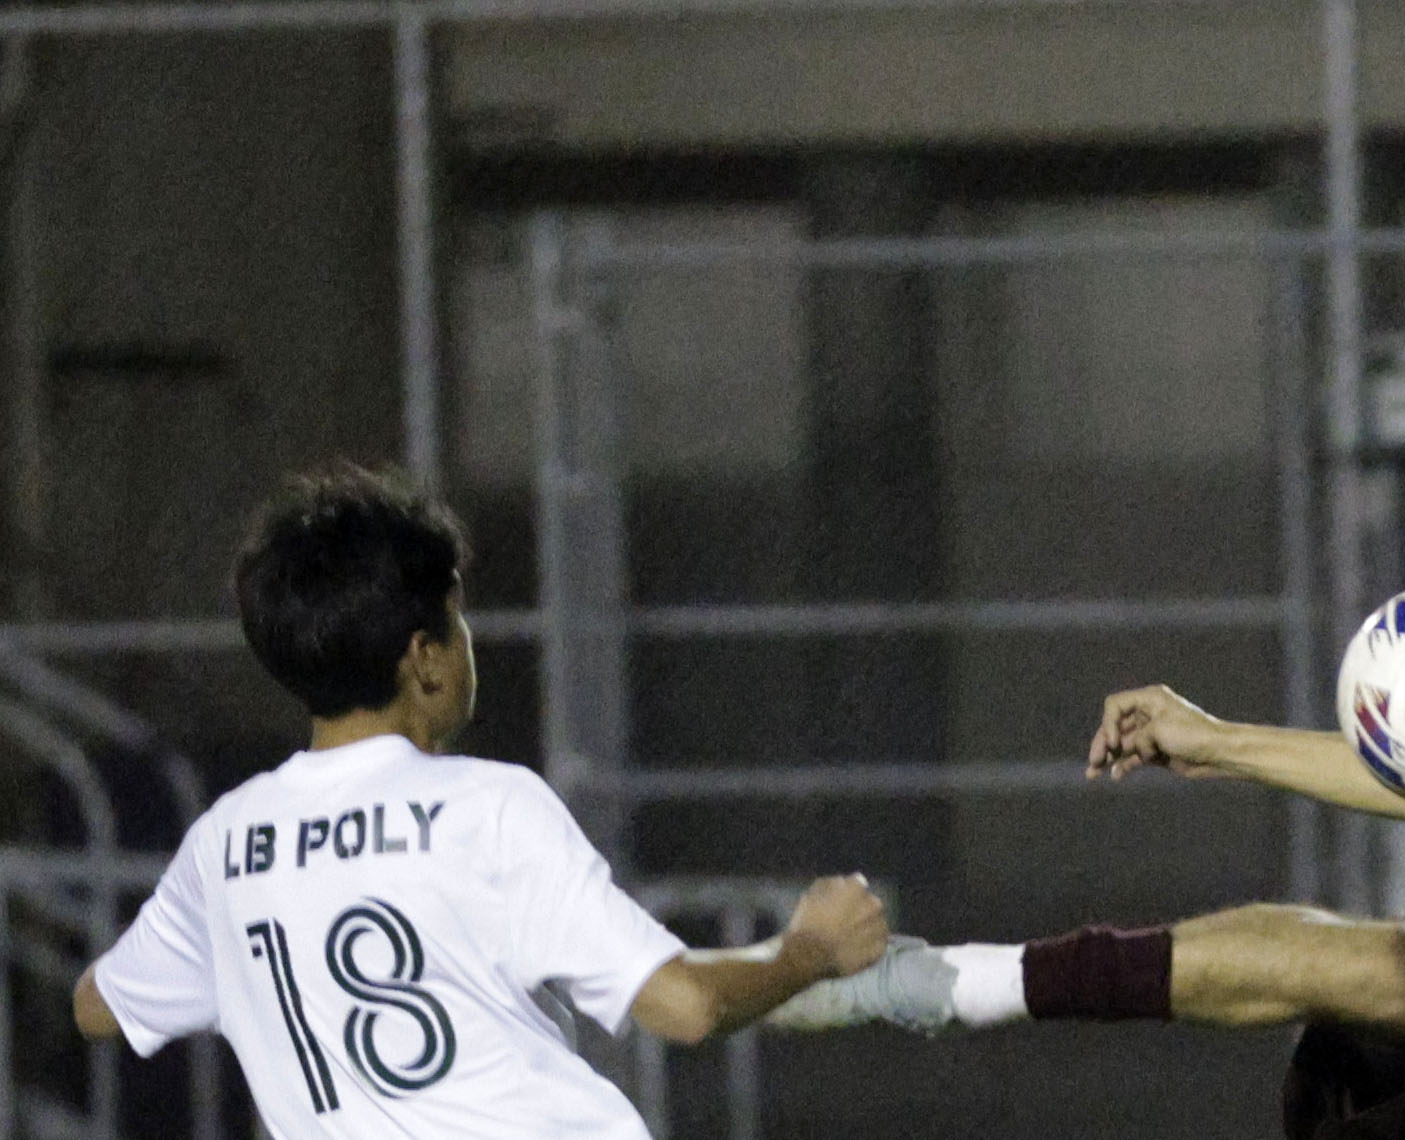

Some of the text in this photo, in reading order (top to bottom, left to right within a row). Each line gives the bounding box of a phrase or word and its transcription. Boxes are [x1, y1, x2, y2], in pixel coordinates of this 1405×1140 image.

[224, 800, 445, 880] LB POLY
[245, 896, 457, 1115] 18
